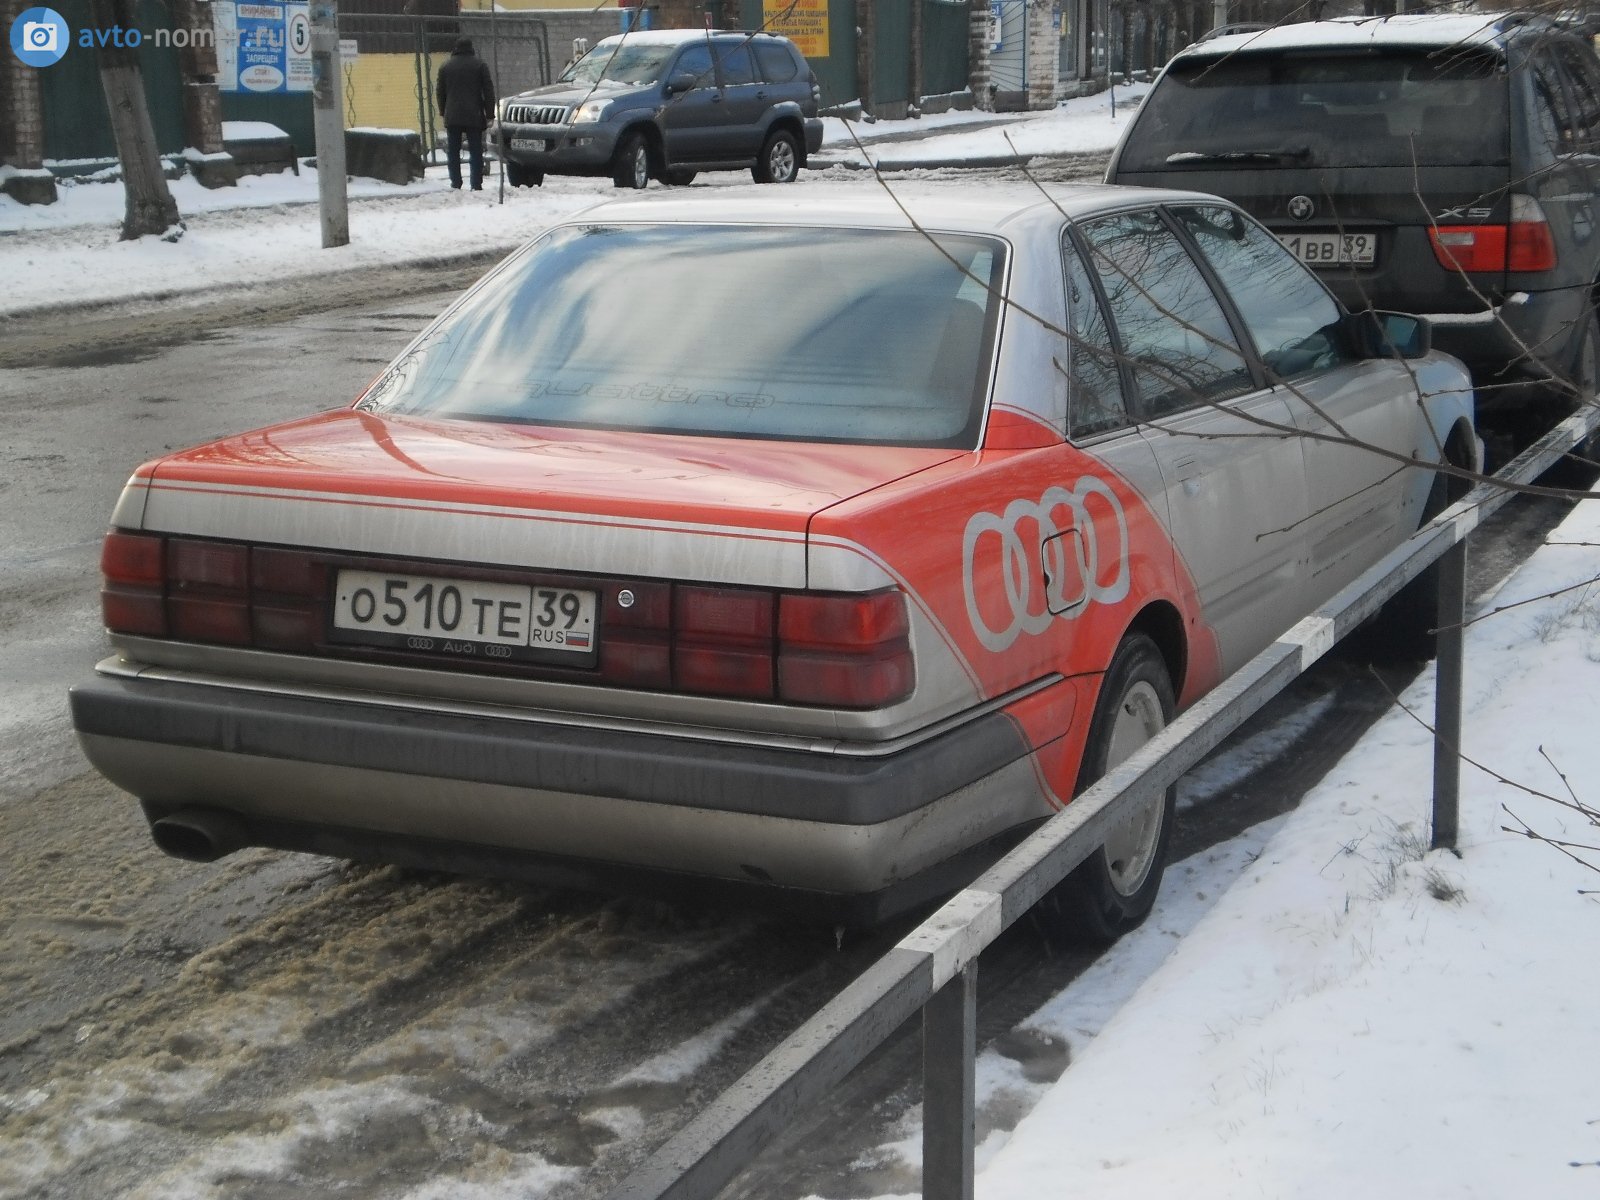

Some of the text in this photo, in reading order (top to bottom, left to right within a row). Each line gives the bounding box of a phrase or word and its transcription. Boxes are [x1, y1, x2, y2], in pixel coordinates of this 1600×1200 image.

[296, 23, 304, 46] 5
[245, 54, 279, 64] ЗАПРЕЩЕН
[1435, 206, 1492, 219] X5
[1343, 236, 1367, 254] 39
[536, 590, 581, 630] 39
[532, 628, 564, 644] RUS
